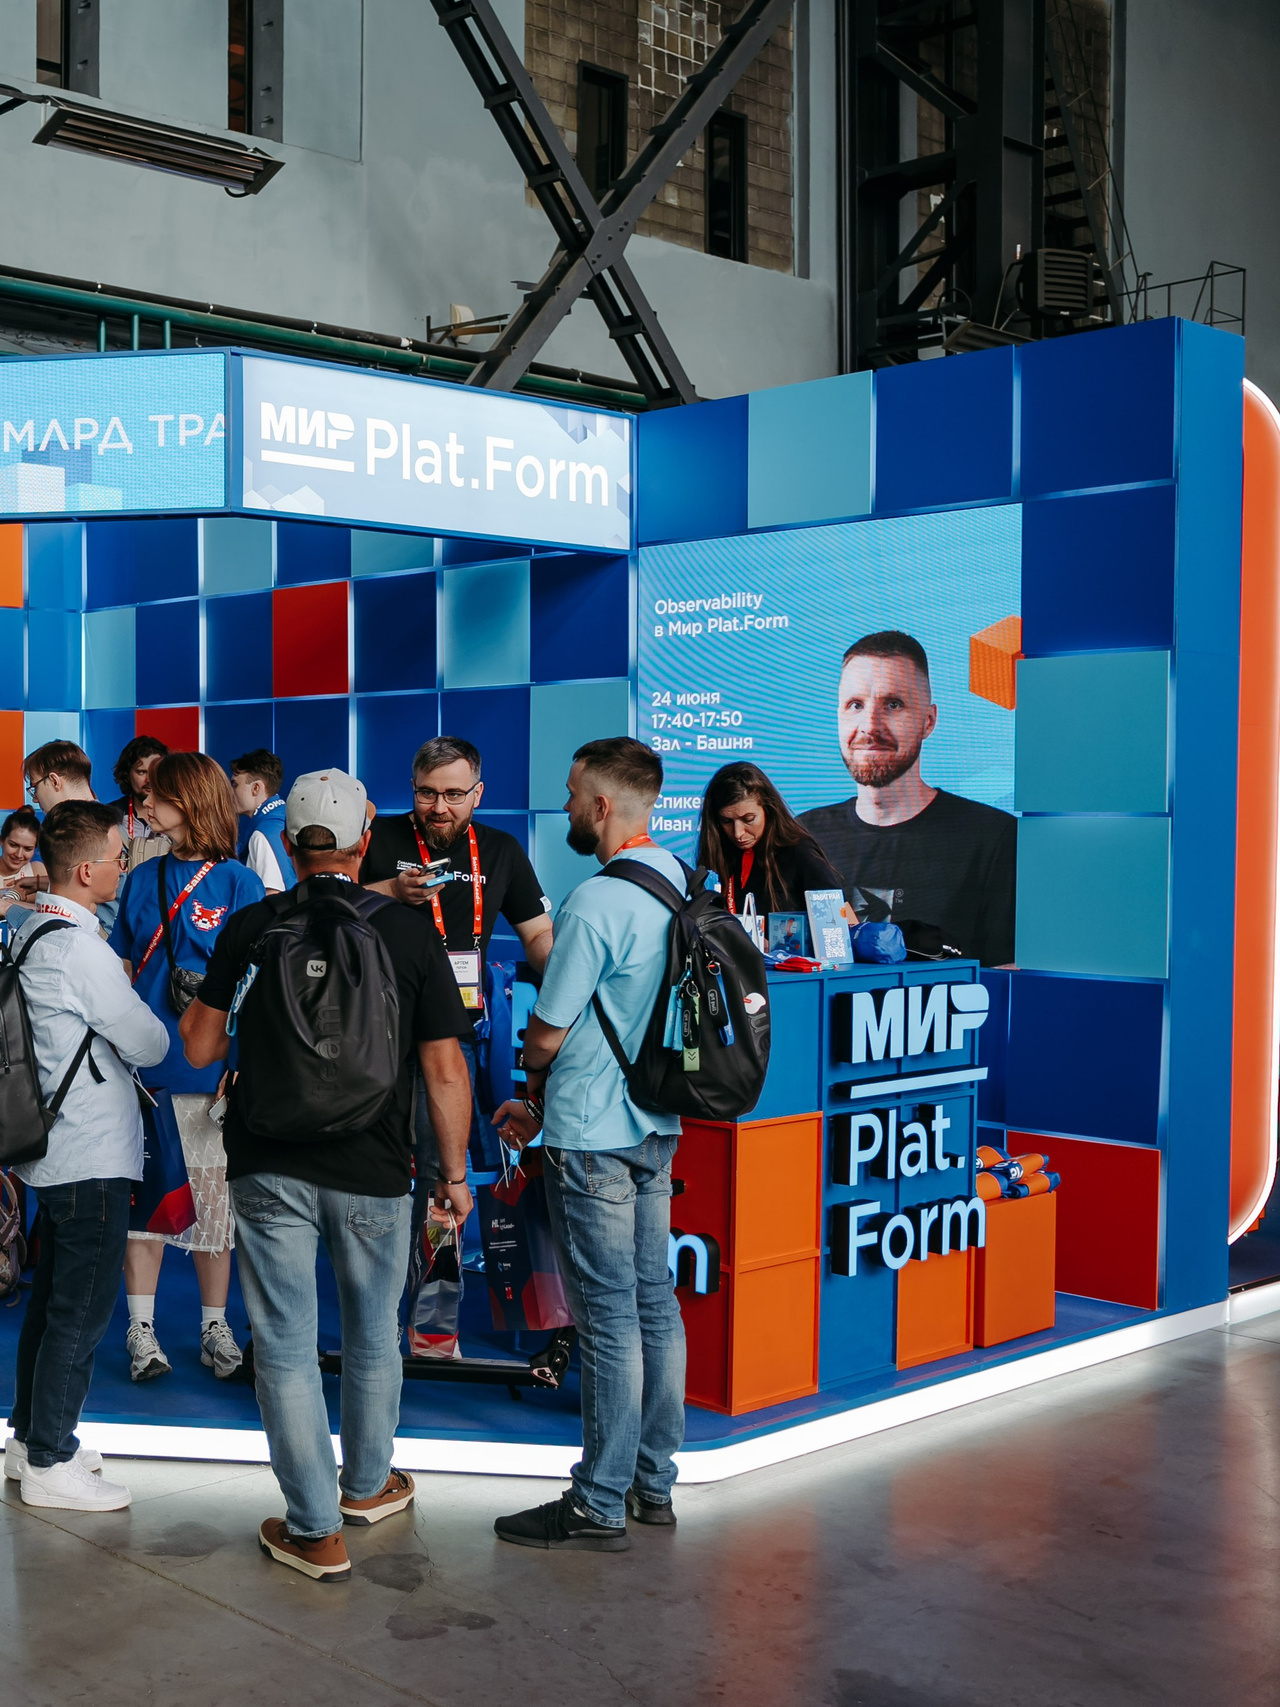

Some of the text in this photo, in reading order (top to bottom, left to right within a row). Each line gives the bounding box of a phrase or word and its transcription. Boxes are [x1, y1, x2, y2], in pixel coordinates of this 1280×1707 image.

[3, 416, 133, 455] МЛРД
[148, 413, 225, 447] ТРА
[260, 402, 609, 506] МИР Plat.Form
[654, 592, 763, 615] Observability
[654, 614, 789, 638] в Мир Plat.Form
[651, 691, 720, 707] 24 июня
[651, 711, 743, 729] 17:40-17:50
[651, 735, 681, 751] Зал
[696, 735, 753, 750] Башня
[654, 794, 705, 809] Спике
[651, 816, 692, 831] Иван
[184, 866, 210, 893] Saint
[812, 892, 840, 901] ВЫИГРАЙ
[310, 964, 324, 973] VK
[852, 983, 990, 1064] МИР
[849, 1104, 966, 1186] Plat.
[848, 1196, 986, 1277] Form
